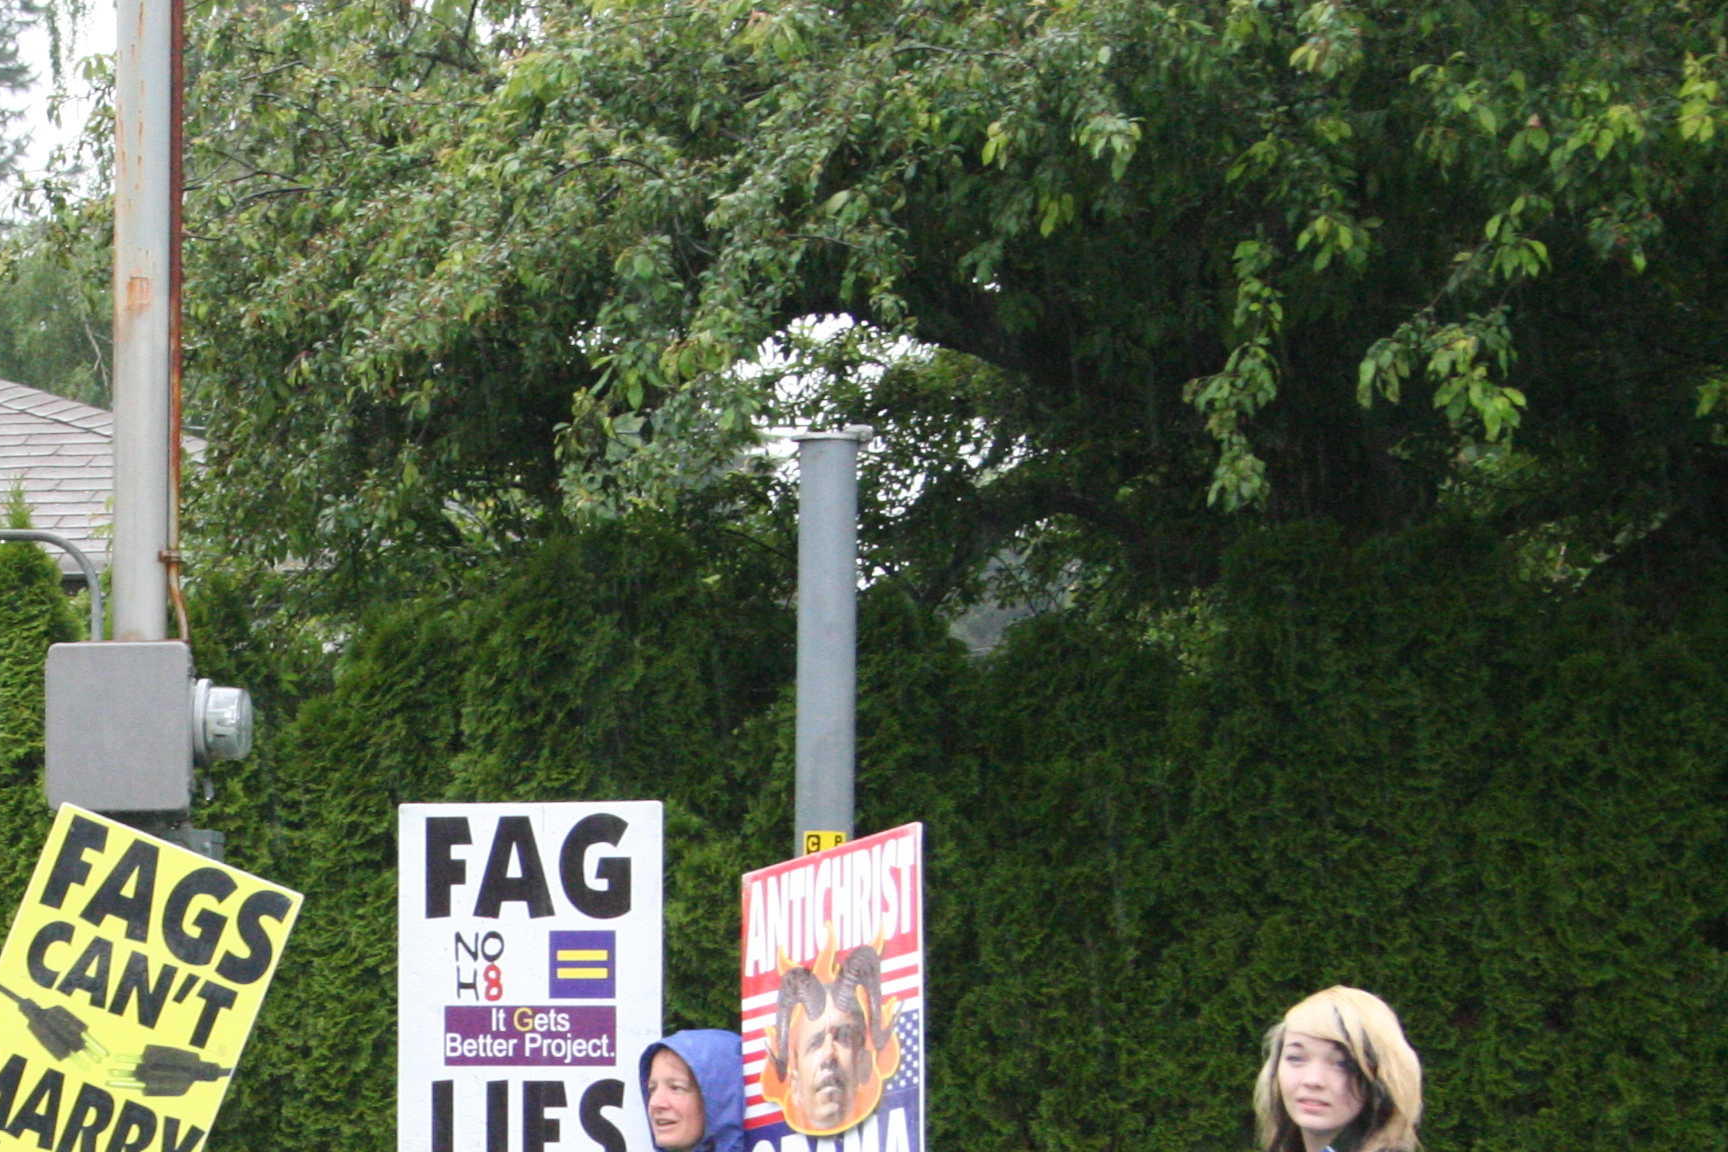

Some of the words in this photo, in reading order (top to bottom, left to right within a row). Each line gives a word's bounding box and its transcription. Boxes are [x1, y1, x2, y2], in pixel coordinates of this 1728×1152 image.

[39, 814, 293, 985] FAGS
[425, 812, 632, 920] FAG
[744, 834, 915, 978] ANTICHRIST
[454, 930, 505, 963] NO
[456, 963, 504, 1002] H8
[26, 920, 239, 1050] CAN'T
[491, 1007, 507, 1032] It
[513, 1006, 571, 1032] Gets
[445, 1033, 518, 1058] Better
[524, 1033, 616, 1064] Project.
